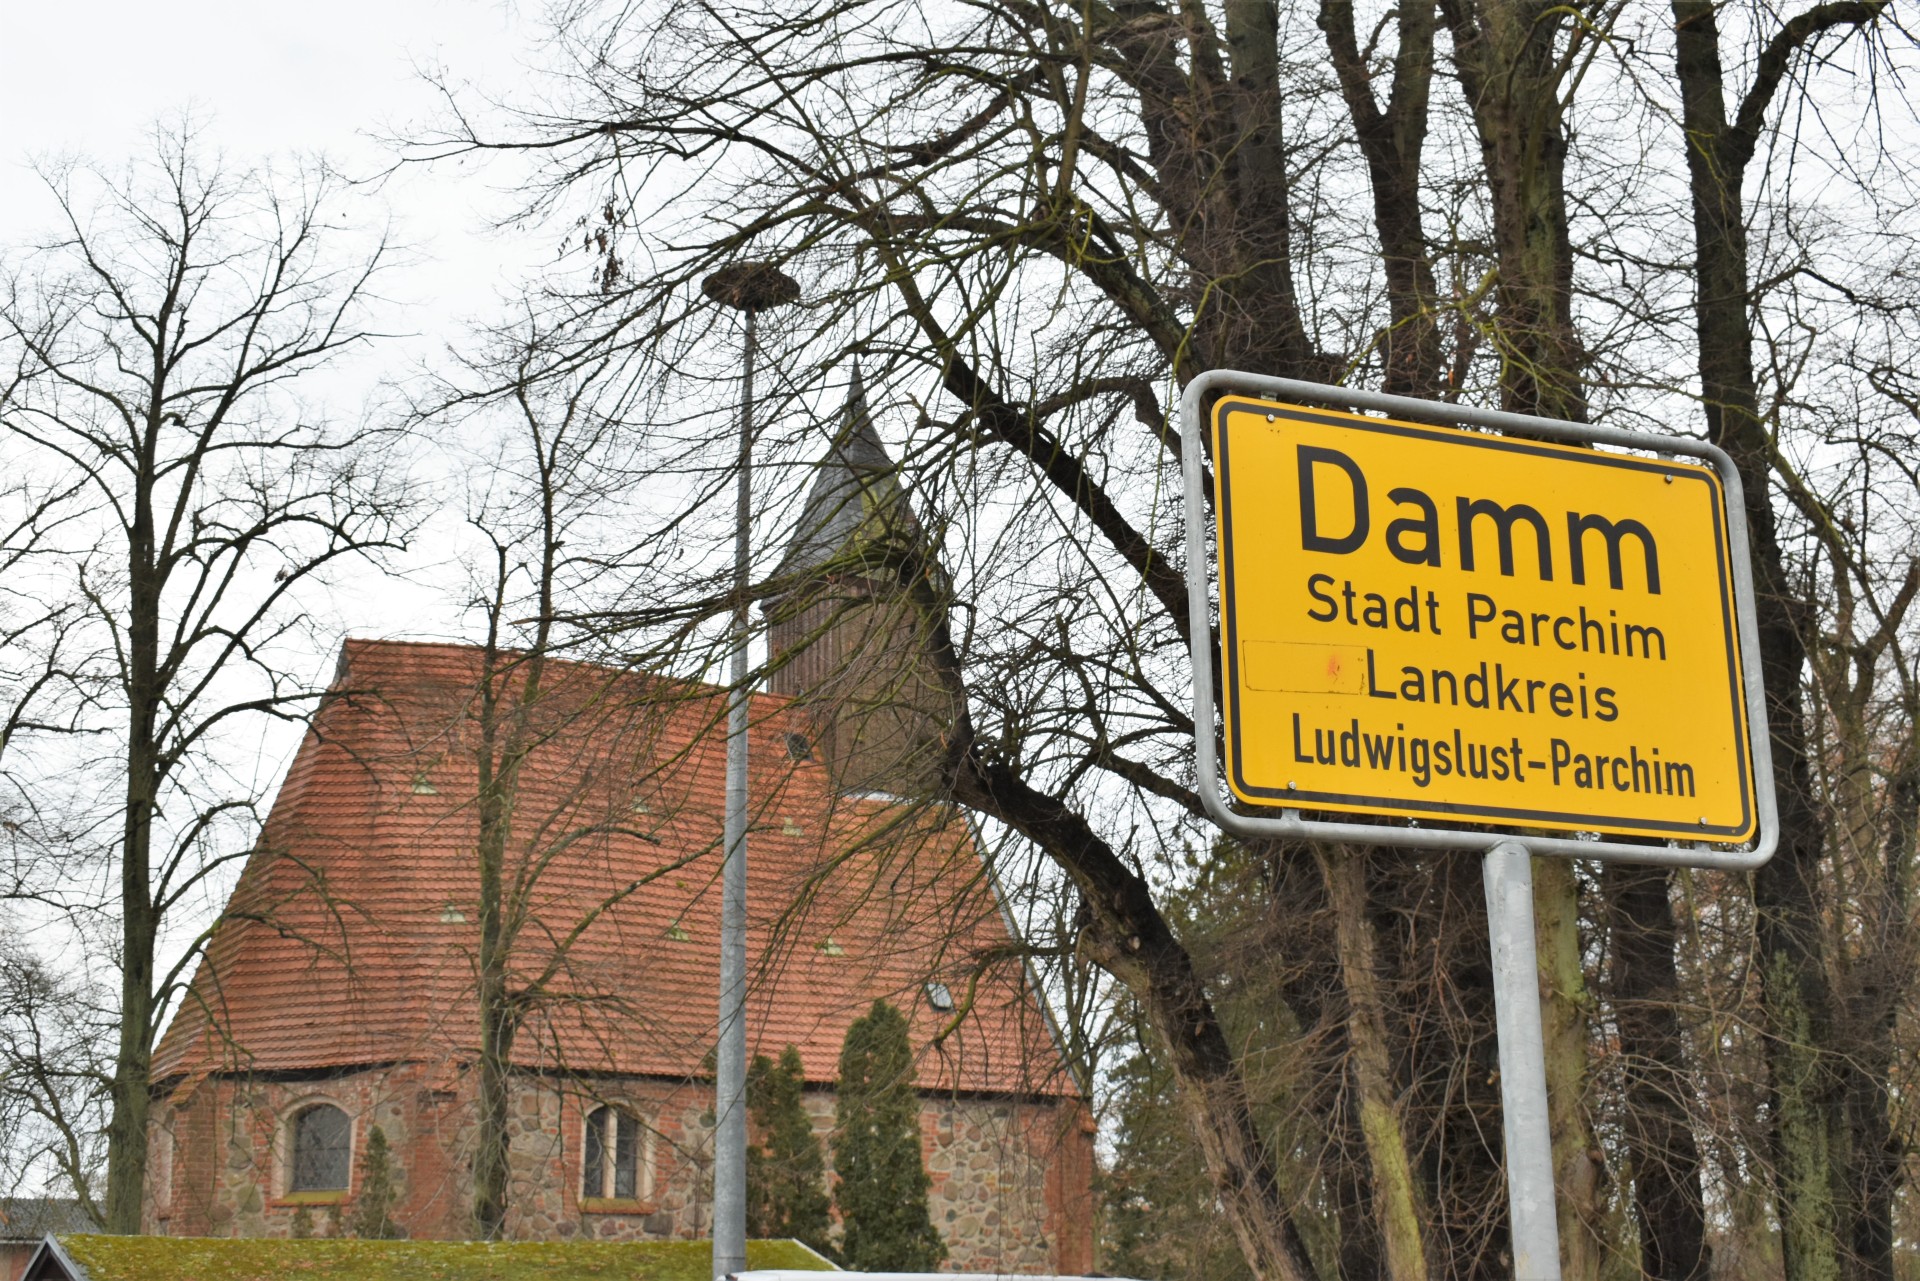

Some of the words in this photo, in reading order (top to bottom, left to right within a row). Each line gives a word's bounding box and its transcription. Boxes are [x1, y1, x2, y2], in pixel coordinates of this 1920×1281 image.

[1297, 444, 1661, 595] Damm
[1307, 573, 1441, 635] Stadt
[1467, 592, 1666, 661] Parchim
[1367, 648, 1619, 722] Landkreis
[1292, 713, 1696, 798] Ludwigslust-Parchim
